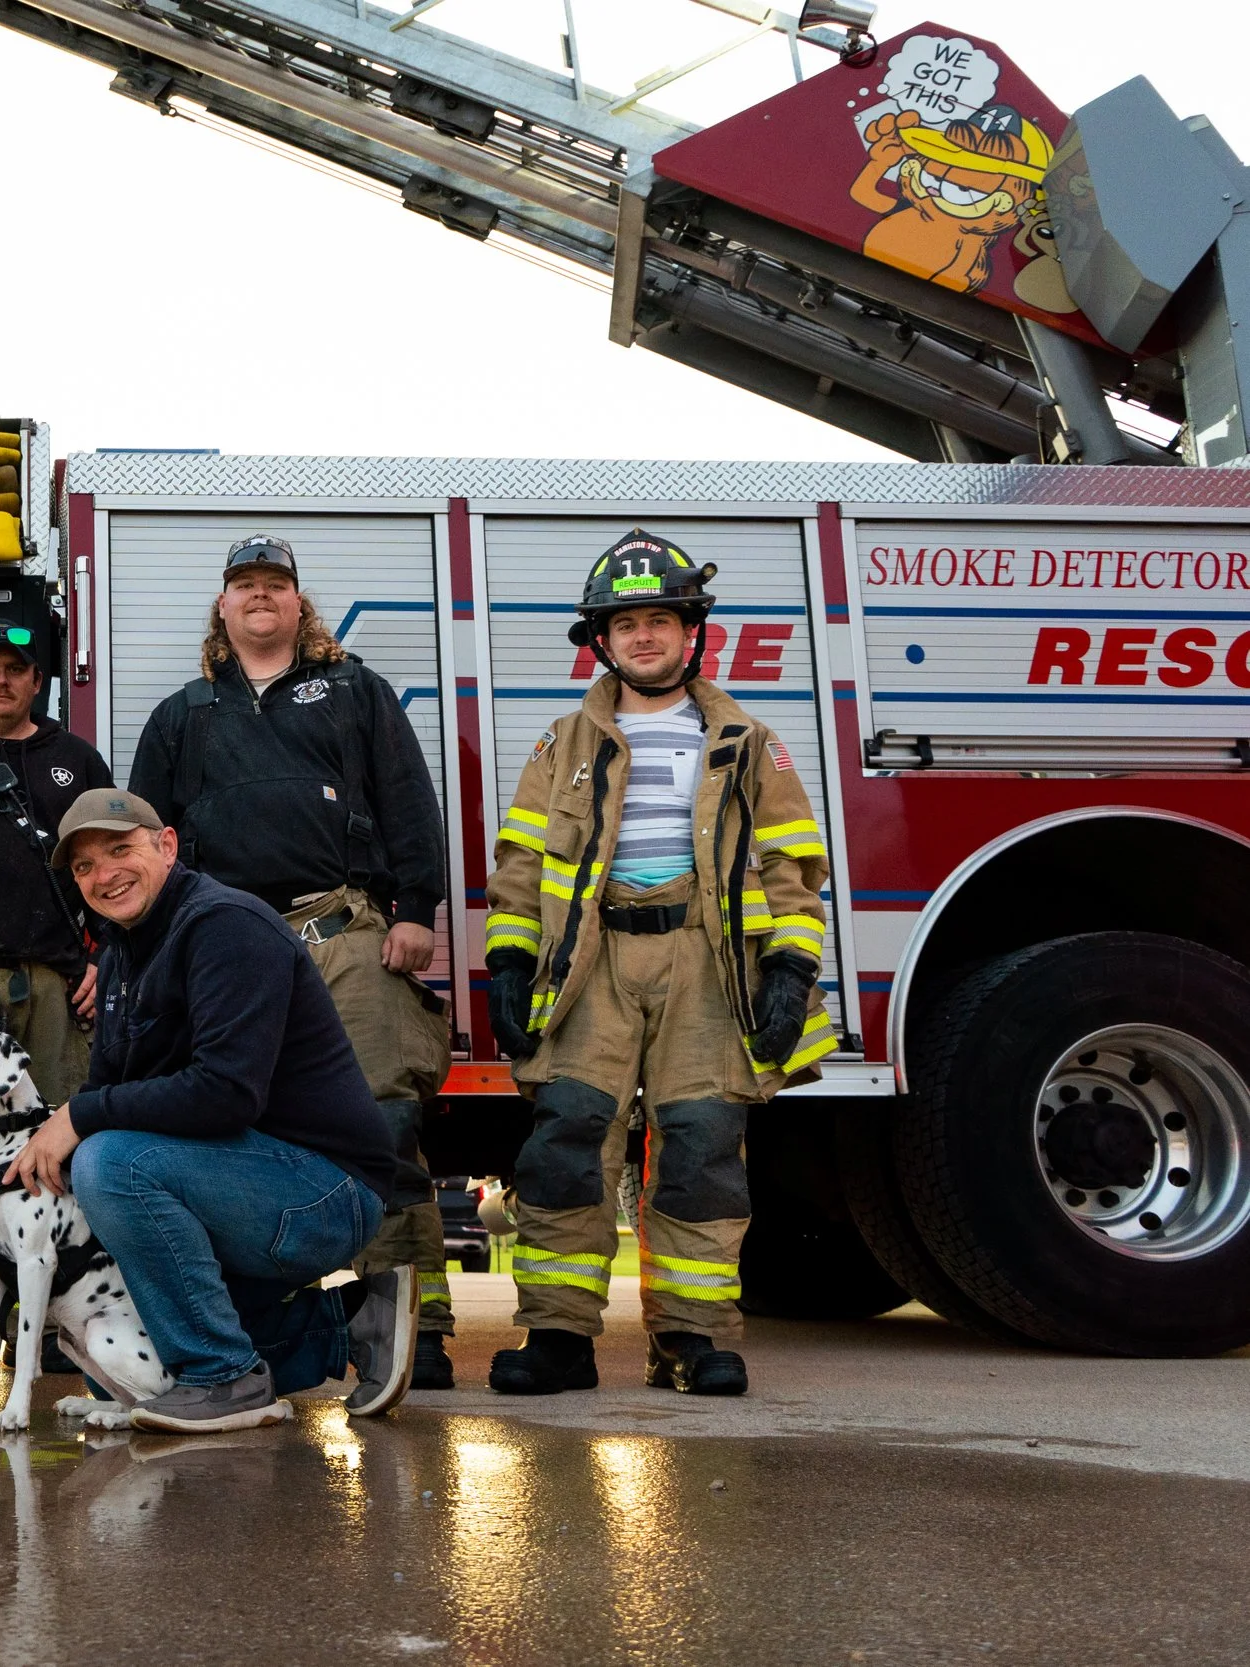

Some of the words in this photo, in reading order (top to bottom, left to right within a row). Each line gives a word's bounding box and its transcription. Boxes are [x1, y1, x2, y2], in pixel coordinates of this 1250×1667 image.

[934, 42, 973, 70] WE
[913, 62, 972, 93] GOT
[903, 81, 959, 114] THIS
[621, 558, 654, 579] 11
[866, 546, 1016, 587] SMOKE
[619, 579, 653, 588] RECRUIT
